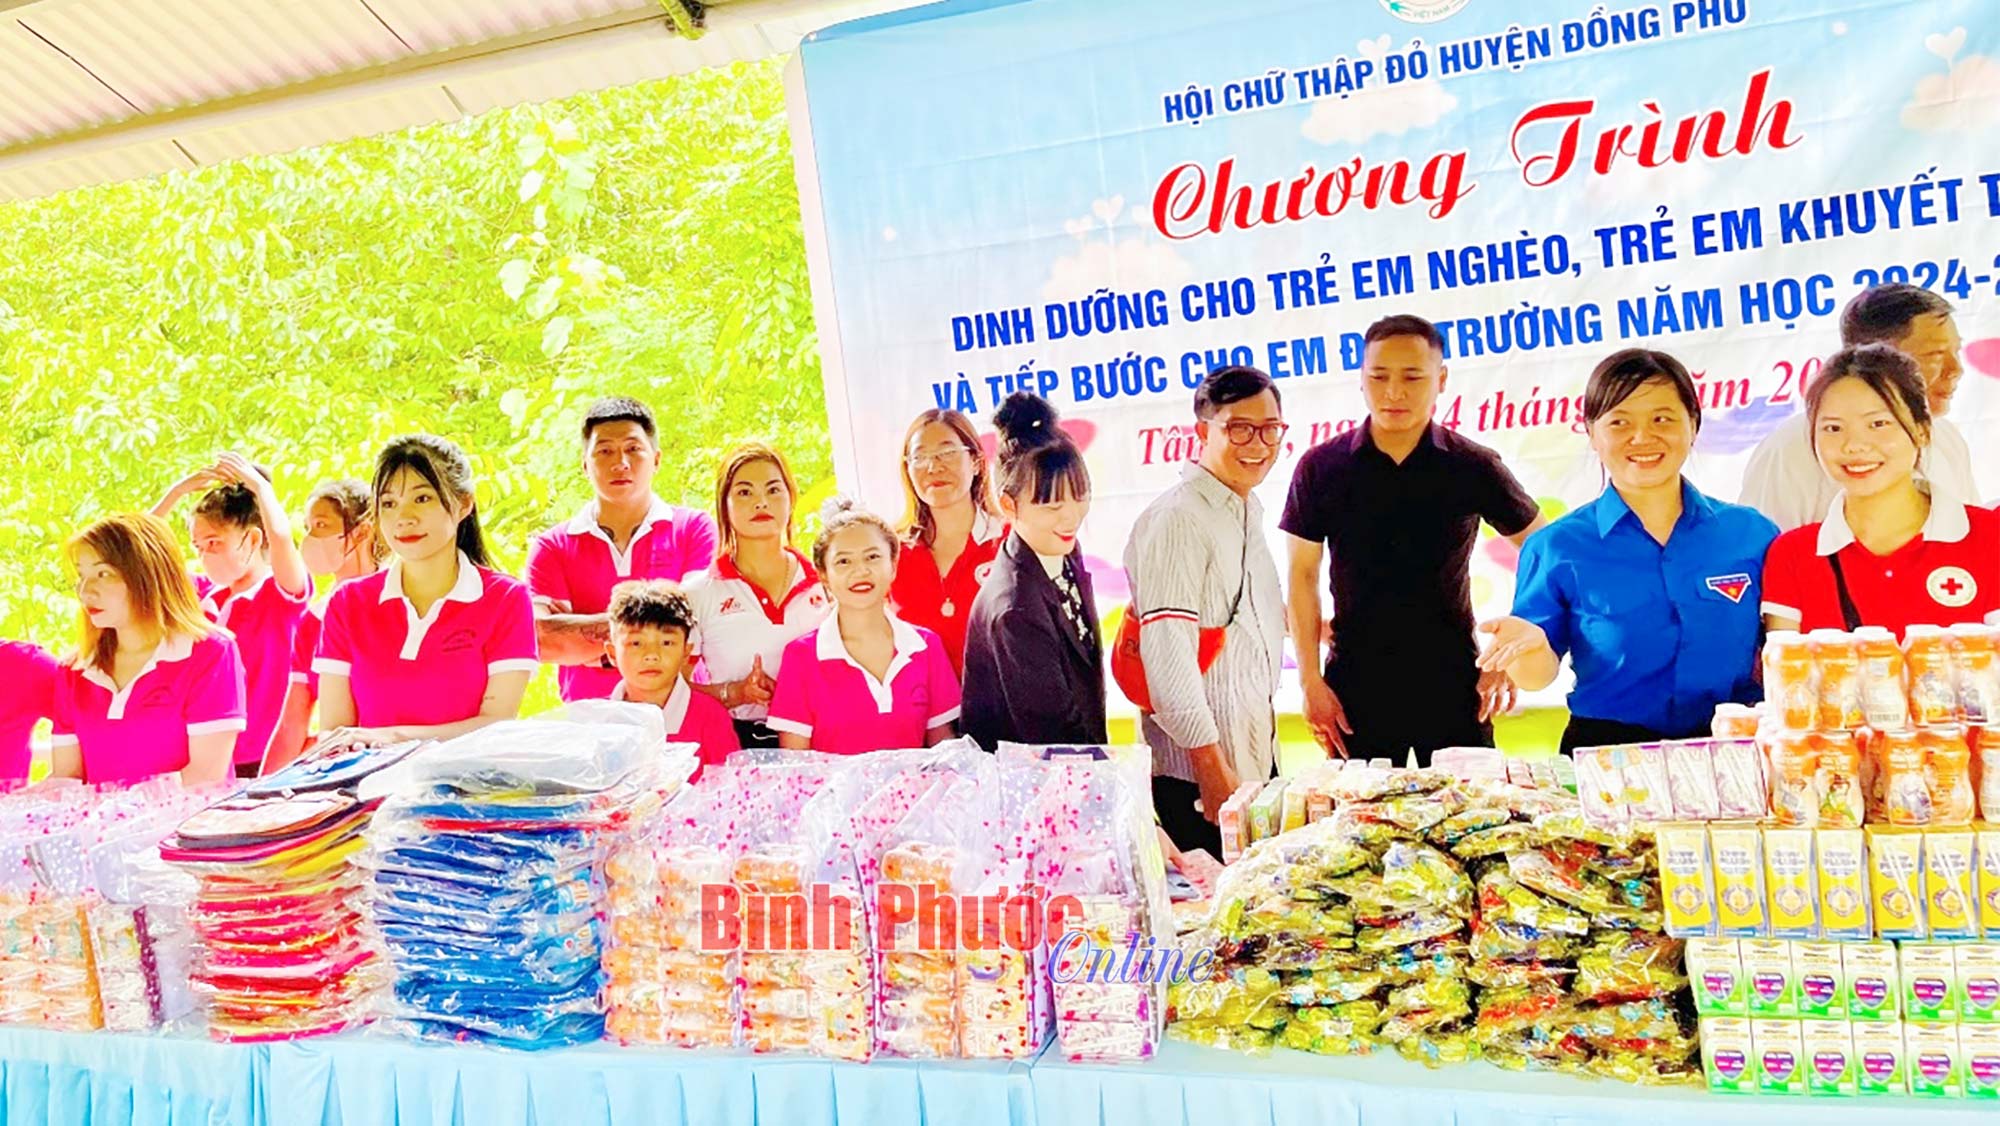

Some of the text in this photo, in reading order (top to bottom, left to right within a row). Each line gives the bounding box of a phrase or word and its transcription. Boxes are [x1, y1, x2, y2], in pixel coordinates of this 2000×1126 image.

[1164, 88, 1214, 125] HỘI
[1224, 66, 1287, 112] CHỮ
[1293, 60, 1374, 101] THẬP
[1385, 41, 1429, 84] ĐỎ
[1440, 27, 1551, 75] HUYỆN
[1562, 6, 1661, 53] ĐỒNG
[1152, 69, 1806, 240] Chương Trình
[951, 307, 1035, 352] DINH
[1044, 287, 1169, 340] DƯỠNG
[1180, 276, 1257, 323] CHO
[1266, 253, 1341, 311] TRẺ
[1351, 254, 1415, 301] EM
[1427, 230, 1582, 293] NGHÈO,
[1593, 205, 1677, 268] TRẺ
[1691, 207, 1763, 256] EM
[1779, 166, 1963, 244] KHUYẾT
[932, 372, 978, 414] VÀ
[984, 359, 1060, 409] TIẾP
[1070, 351, 1169, 402] BƯỚC
[1267, 336, 1328, 380] EM
[1432, 301, 1604, 360] TRƯỜNG
[1617, 284, 1724, 339] NĂM
[1739, 273, 1836, 330] HỌC
